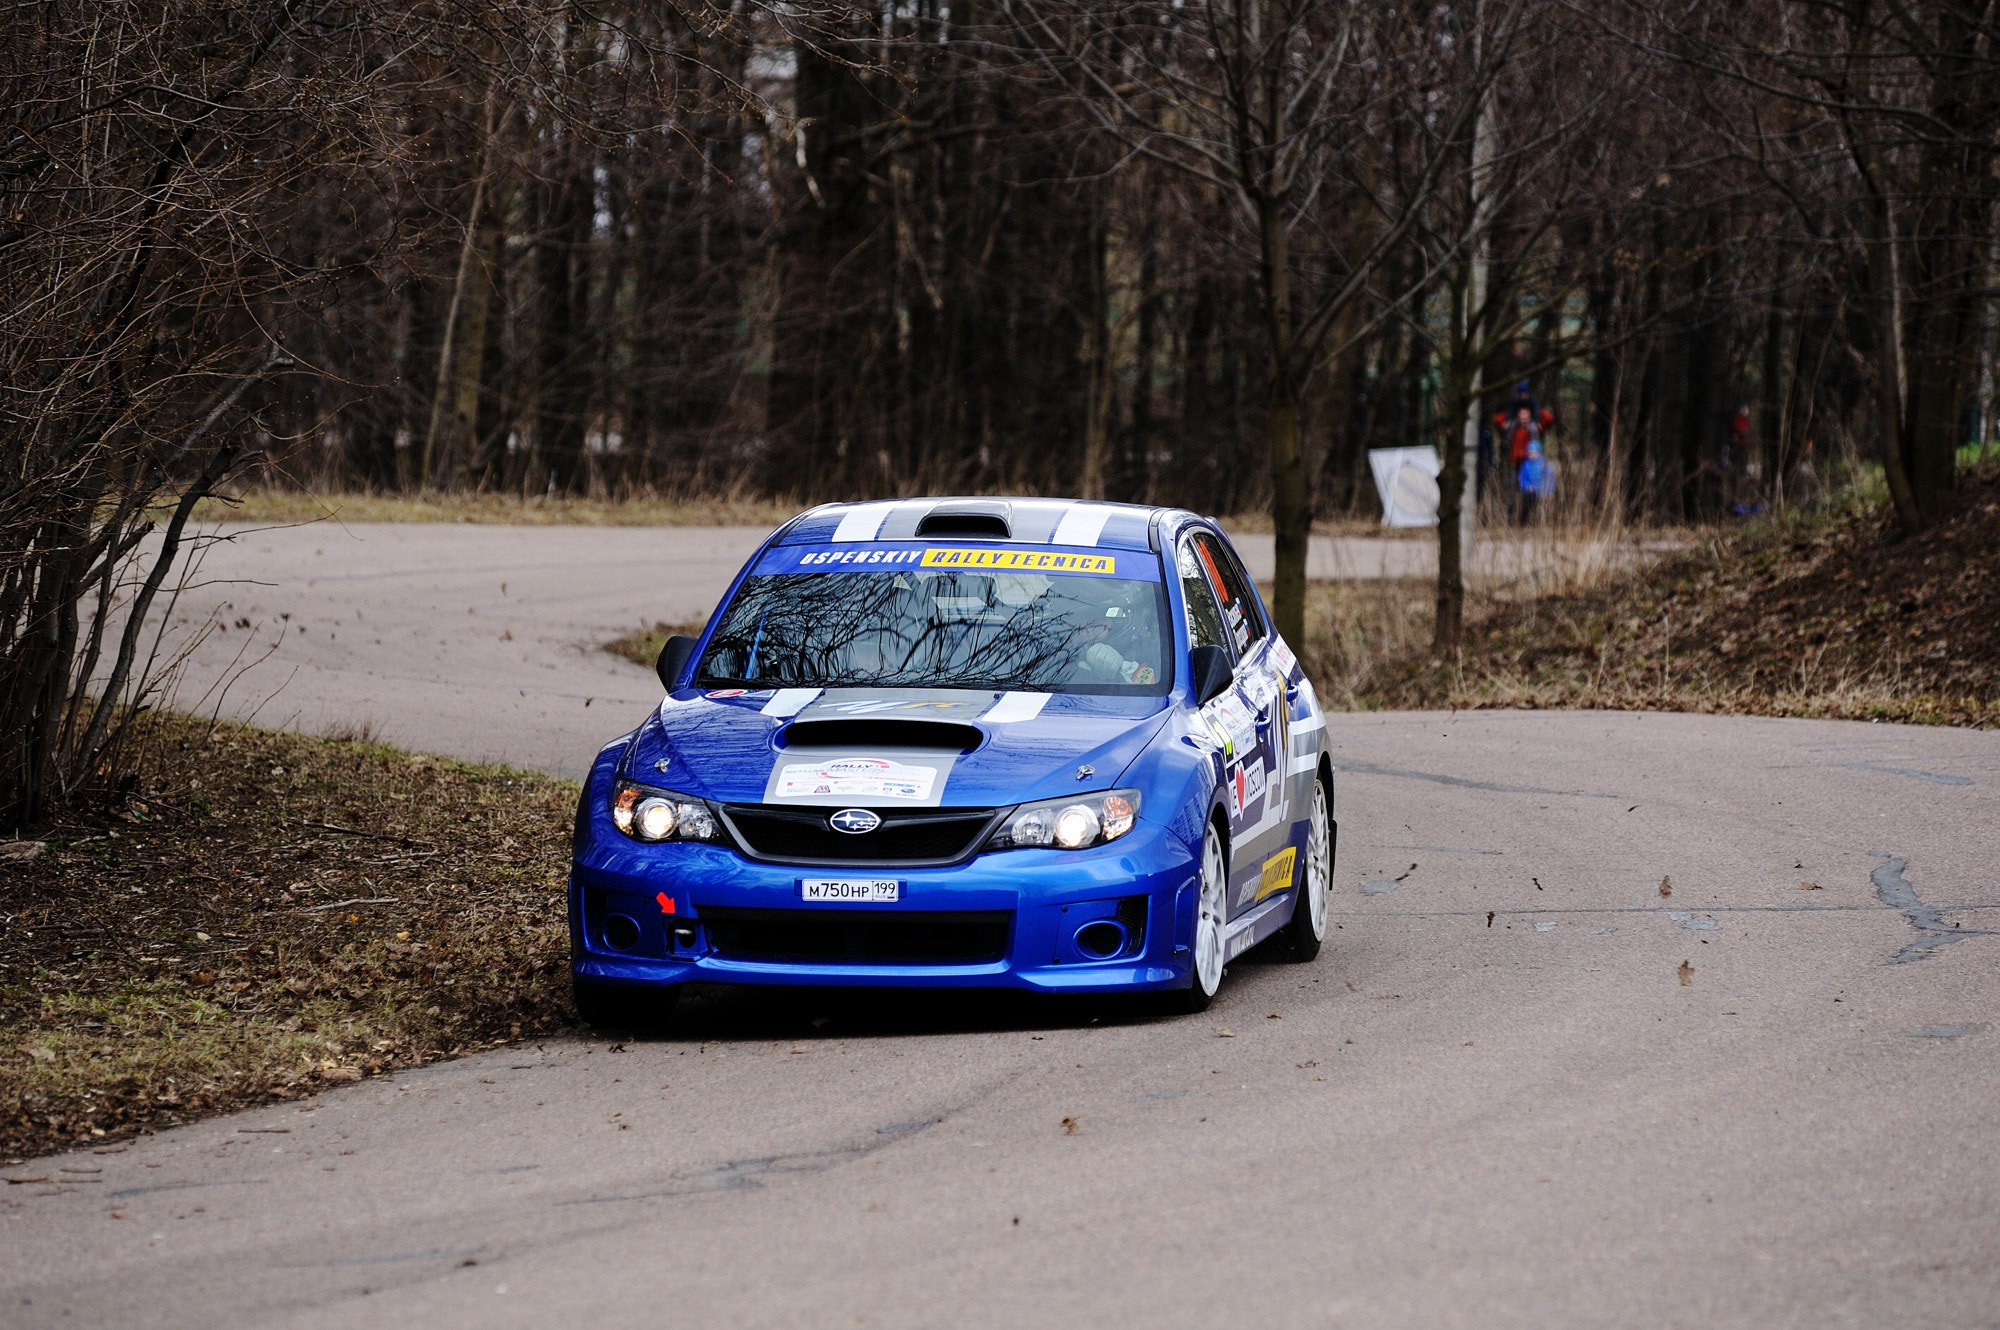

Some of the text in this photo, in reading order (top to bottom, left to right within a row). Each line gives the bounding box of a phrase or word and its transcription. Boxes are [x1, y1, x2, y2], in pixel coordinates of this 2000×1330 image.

[800, 550, 1107, 570] USPENSKIY RALLY TECNICA
[874, 883, 896, 894] 199
